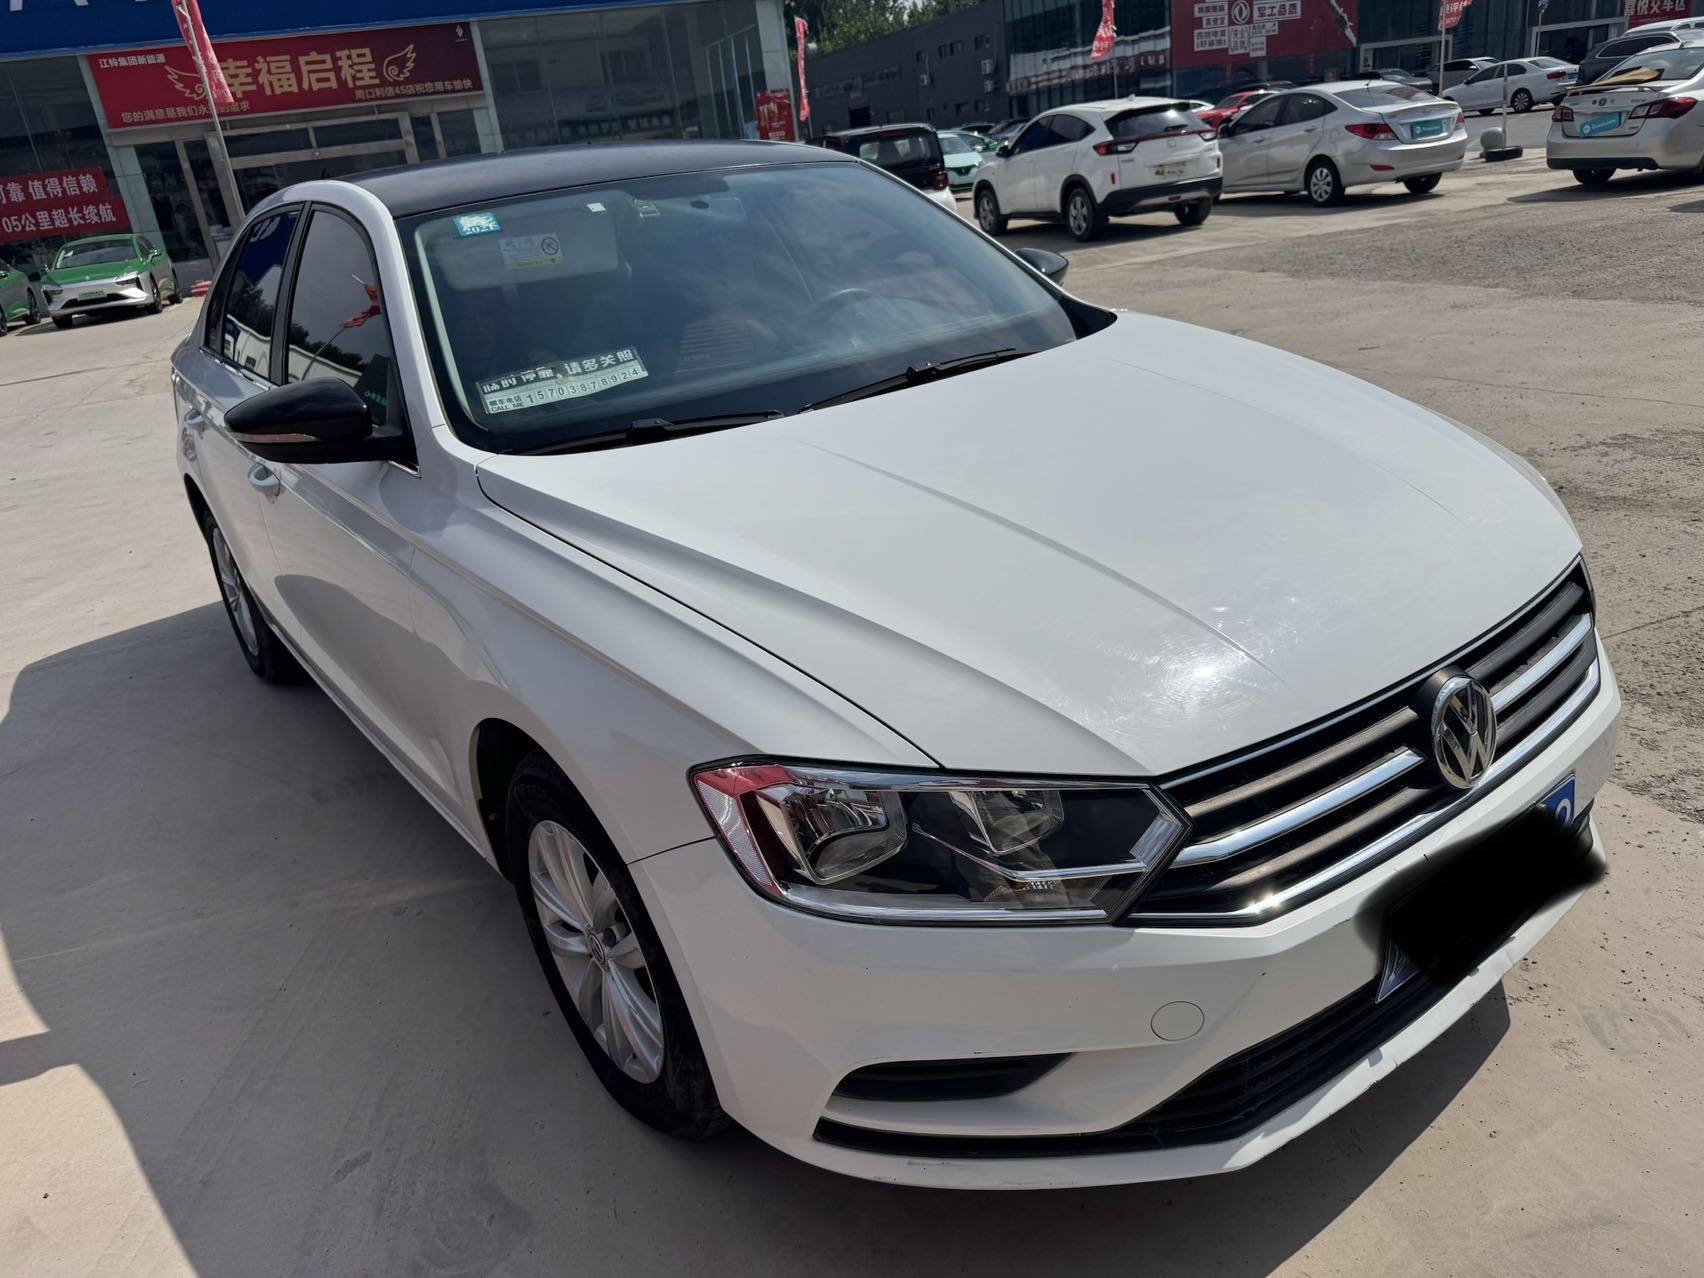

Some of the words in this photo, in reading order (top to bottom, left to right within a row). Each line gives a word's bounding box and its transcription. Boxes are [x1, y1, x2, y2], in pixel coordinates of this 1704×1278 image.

[99, 53, 166, 68] 江铃集团新能源
[219, 47, 380, 98] 幸福启程
[121, 101, 250, 123] 您的满意是我们永的追求
[28, 174, 98, 200] 值得信赖
[2, 203, 116, 233] 05公里超长续航
[526, 367, 640, 404] 15703878924
